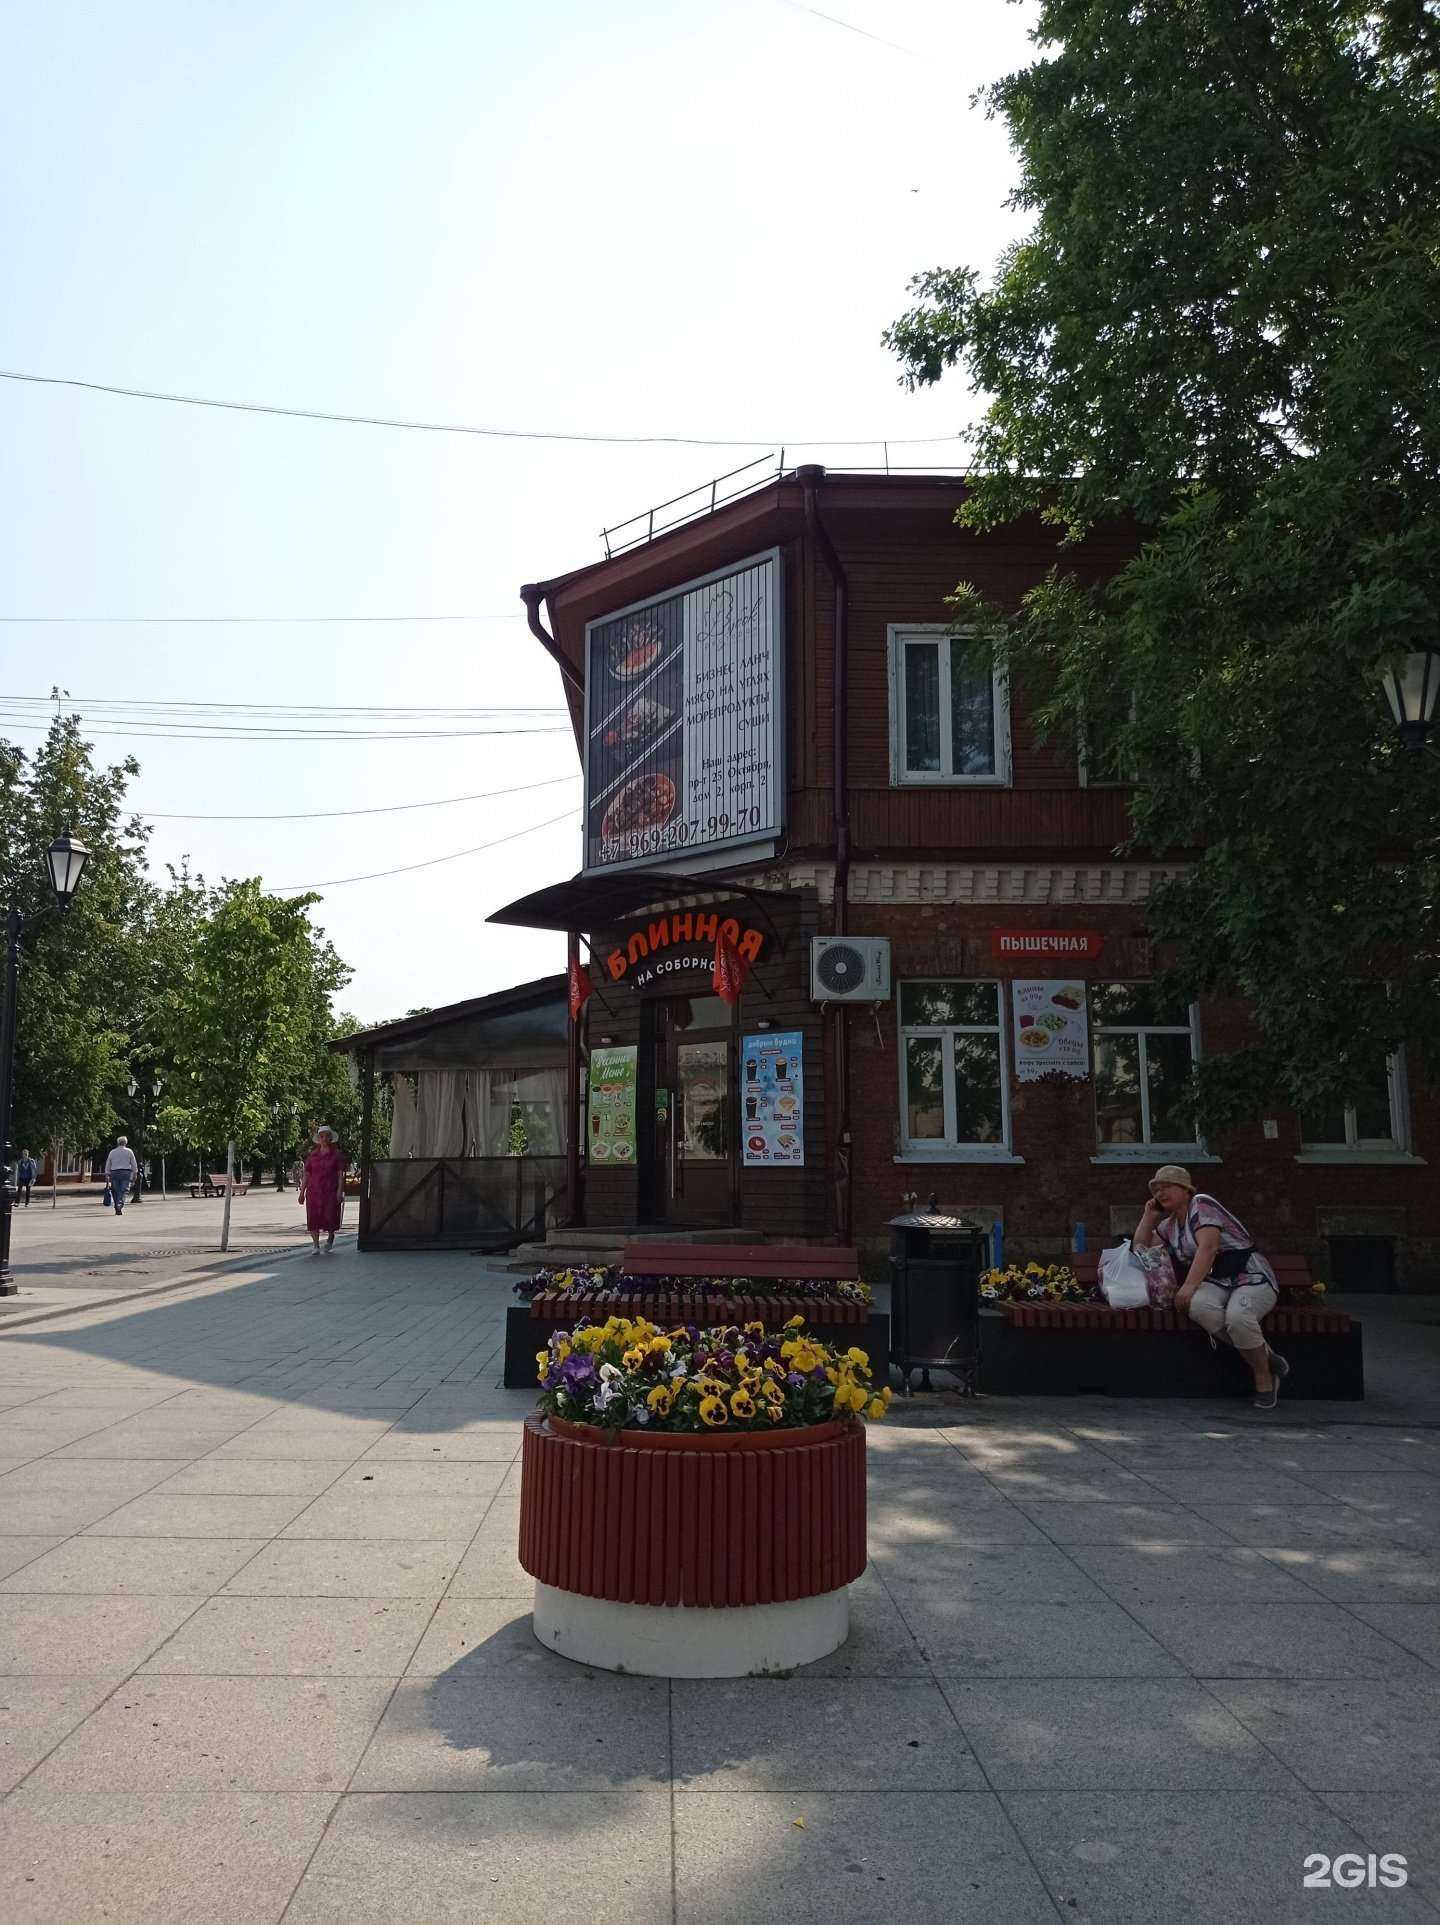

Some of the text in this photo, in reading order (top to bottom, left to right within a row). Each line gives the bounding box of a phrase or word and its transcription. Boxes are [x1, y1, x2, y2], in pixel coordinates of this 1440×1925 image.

[696, 650, 769, 684] БИЗНЕС ЛАНЧ
[686, 672, 769, 707] МЯСО НА УГЛЯХ
[687, 692, 769, 726] МОРЕПРОДУКТЫ
[738, 712, 769, 731] СУШИ
[702, 748, 756, 770] Наш адрес:
[712, 771, 722, 782] 25
[728, 760, 771, 778] Октября,
[693, 792, 710, 802] дом
[730, 780, 754, 795] корп.
[760, 775, 766, 786] 2
[600, 806, 760, 861] +7 969-207-99-70
[607, 912, 763, 981] БЛИННАЯ
[1000, 937, 1088, 951] ПЫШЕЧНАЯ
[637, 957, 716, 985] НА СОБОРНО
